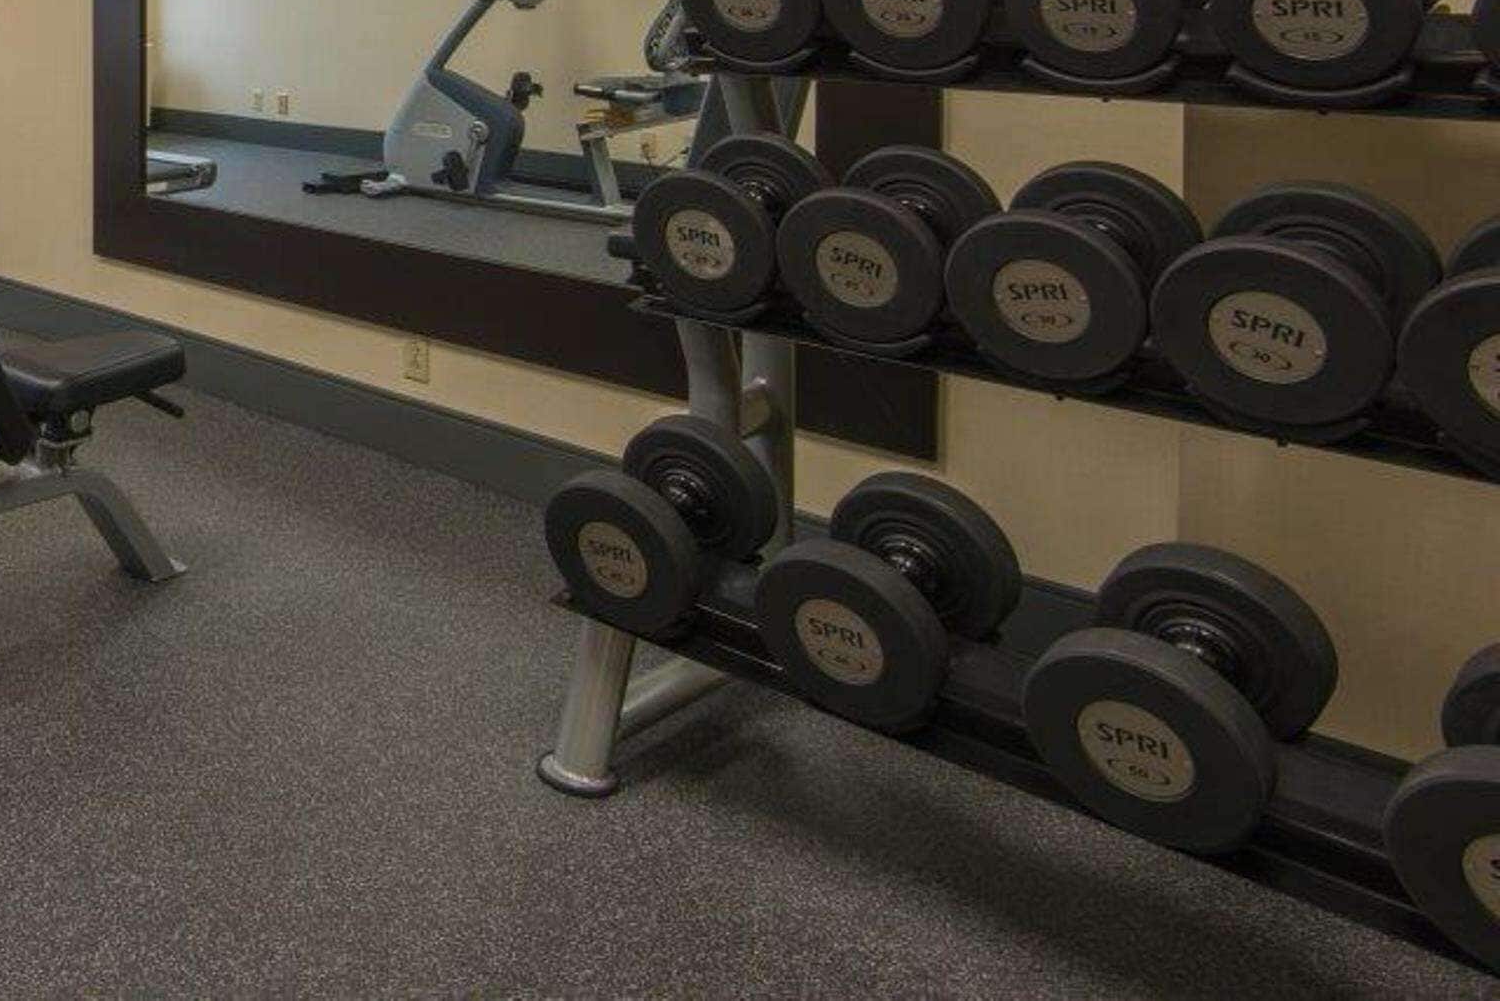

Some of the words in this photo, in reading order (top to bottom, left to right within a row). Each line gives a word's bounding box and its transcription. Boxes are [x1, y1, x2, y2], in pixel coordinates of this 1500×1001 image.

[1273, 0, 1343, 18] SPRI
[677, 226, 720, 247] SPRI
[832, 247, 882, 278] SPRI
[1009, 283, 1068, 301] SPRI
[1232, 310, 1304, 347] SPRI
[808, 616, 864, 649] SPRI
[1097, 723, 1169, 759] SPRI
